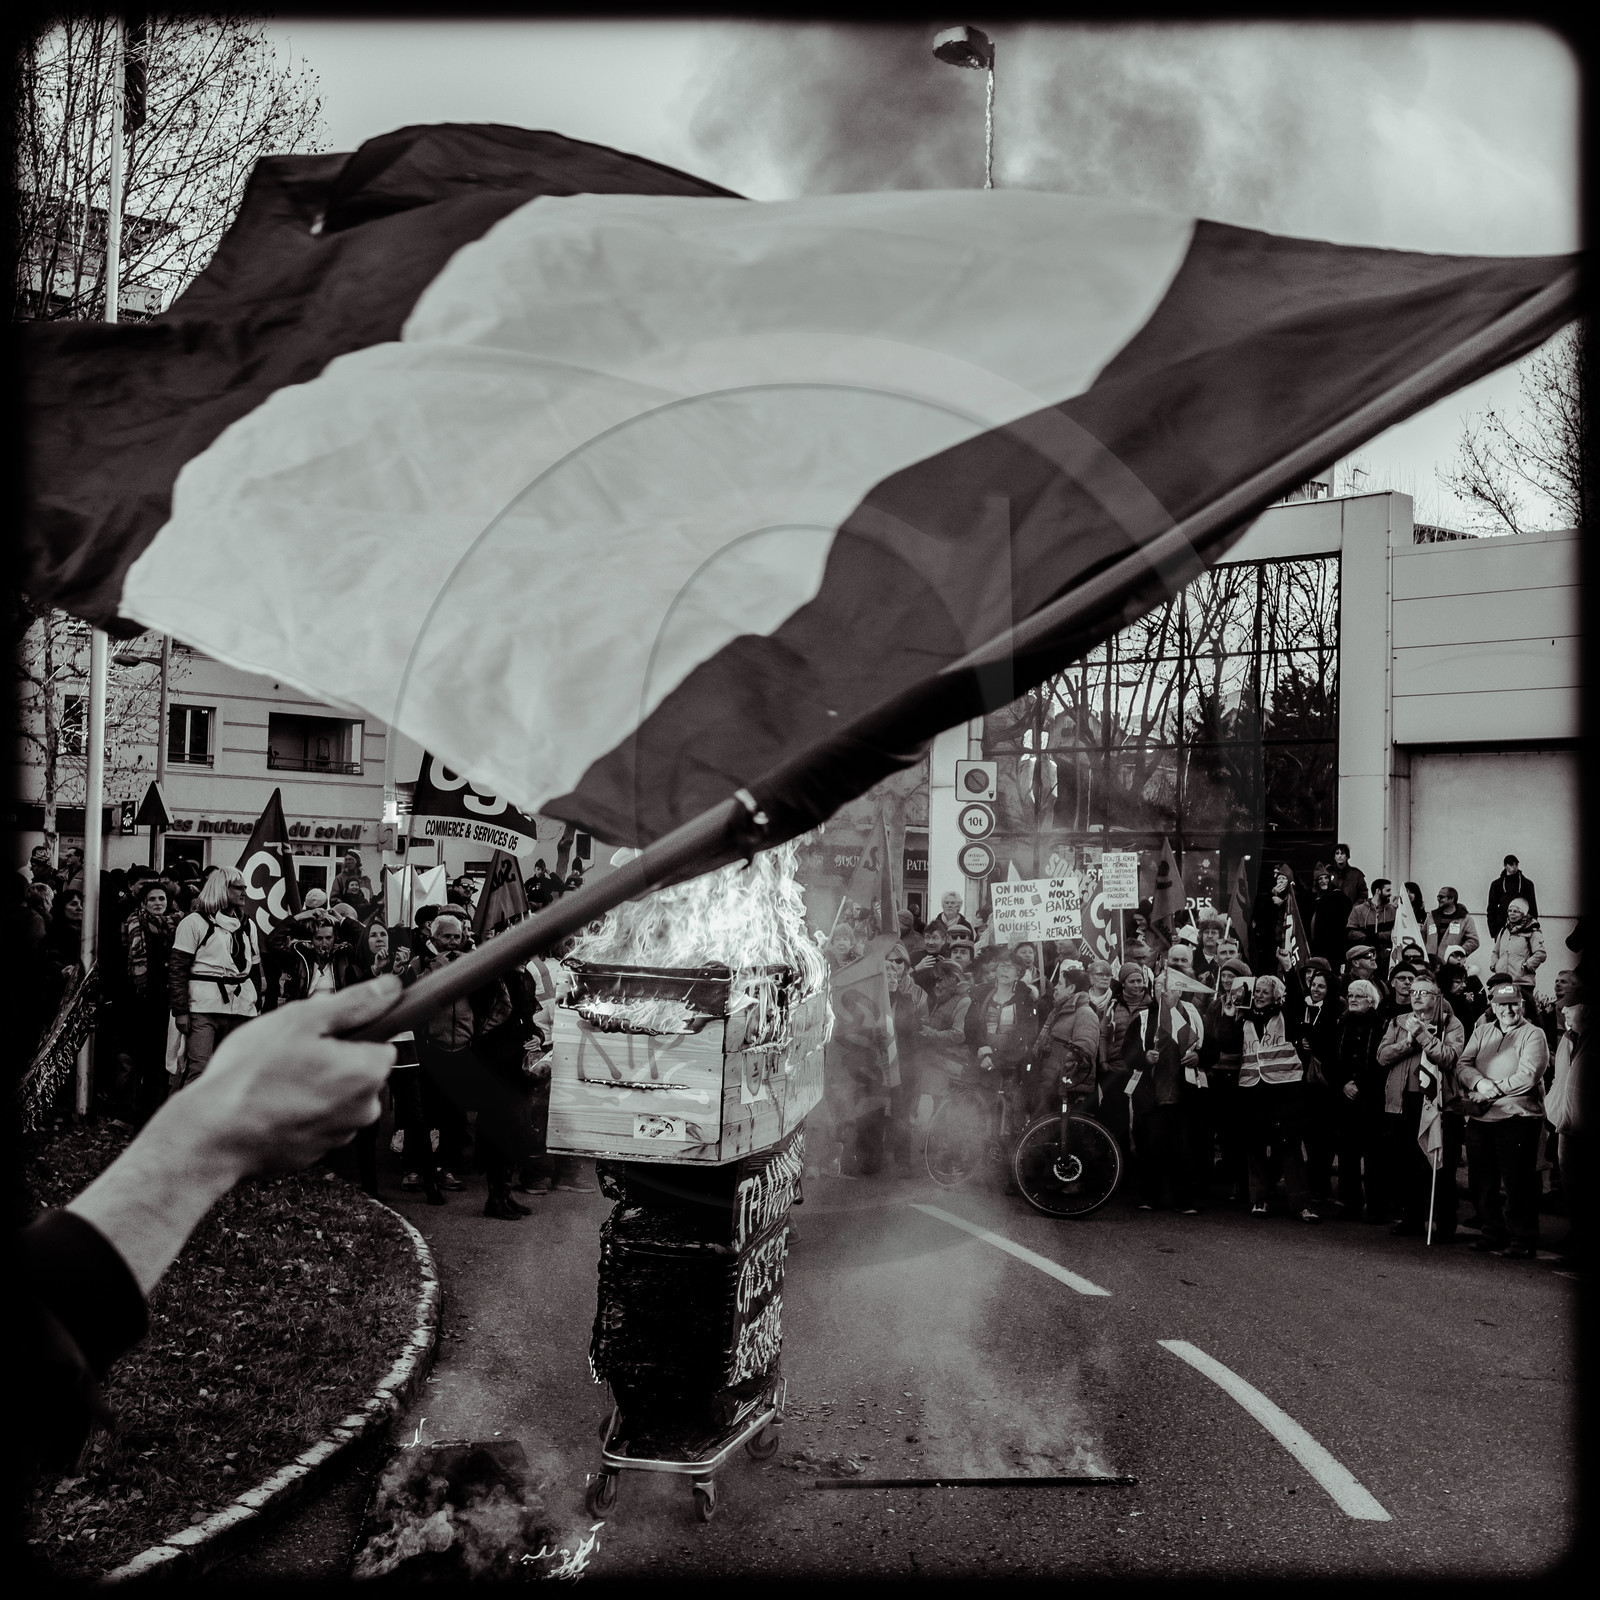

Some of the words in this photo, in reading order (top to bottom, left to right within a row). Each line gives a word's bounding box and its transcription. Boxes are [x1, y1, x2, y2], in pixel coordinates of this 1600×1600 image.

[967, 817, 983, 827] 10t
[289, 821, 310, 837] du
[315, 823, 363, 840] soleil
[424, 819, 465, 838] COMMERCE
[464, 823, 472, 839] &
[472, 824, 509, 850] SERVICES
[507, 835, 519, 851] 05
[996, 884, 1011, 895] ON
[1013, 883, 1038, 894] NOUS
[1049, 879, 1065, 888] ON
[1048, 890, 1076, 899] NOUS
[994, 895, 1025, 907] PREND
[995, 909, 1017, 920] POUR
[1019, 908, 1036, 918] DES
[1053, 915, 1073, 924] NOS
[1045, 925, 1082, 938] RETRAITES
